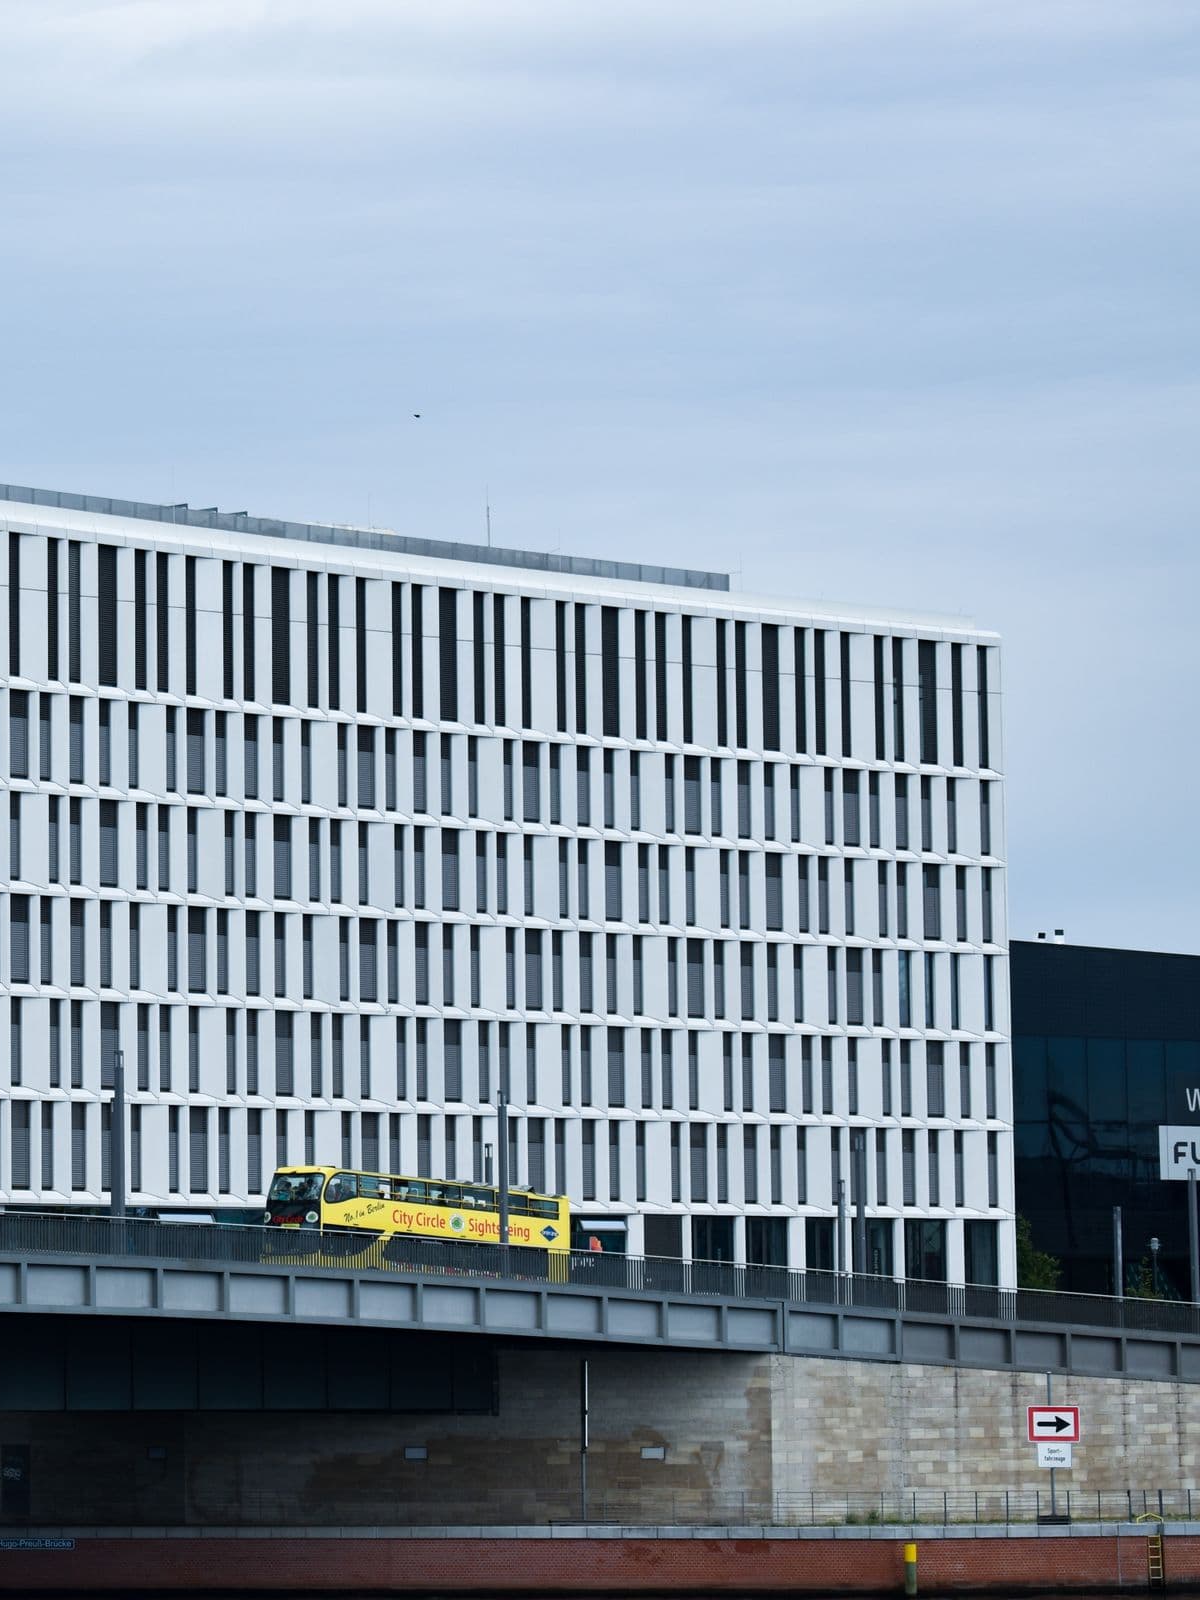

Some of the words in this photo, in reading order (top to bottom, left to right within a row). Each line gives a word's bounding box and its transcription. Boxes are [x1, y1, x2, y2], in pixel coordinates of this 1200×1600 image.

[366, 1202, 385, 1214] Berlin
[392, 1209, 413, 1228] City
[416, 1212, 446, 1229] Circle
[468, 1217, 530, 1242] Sightseing
